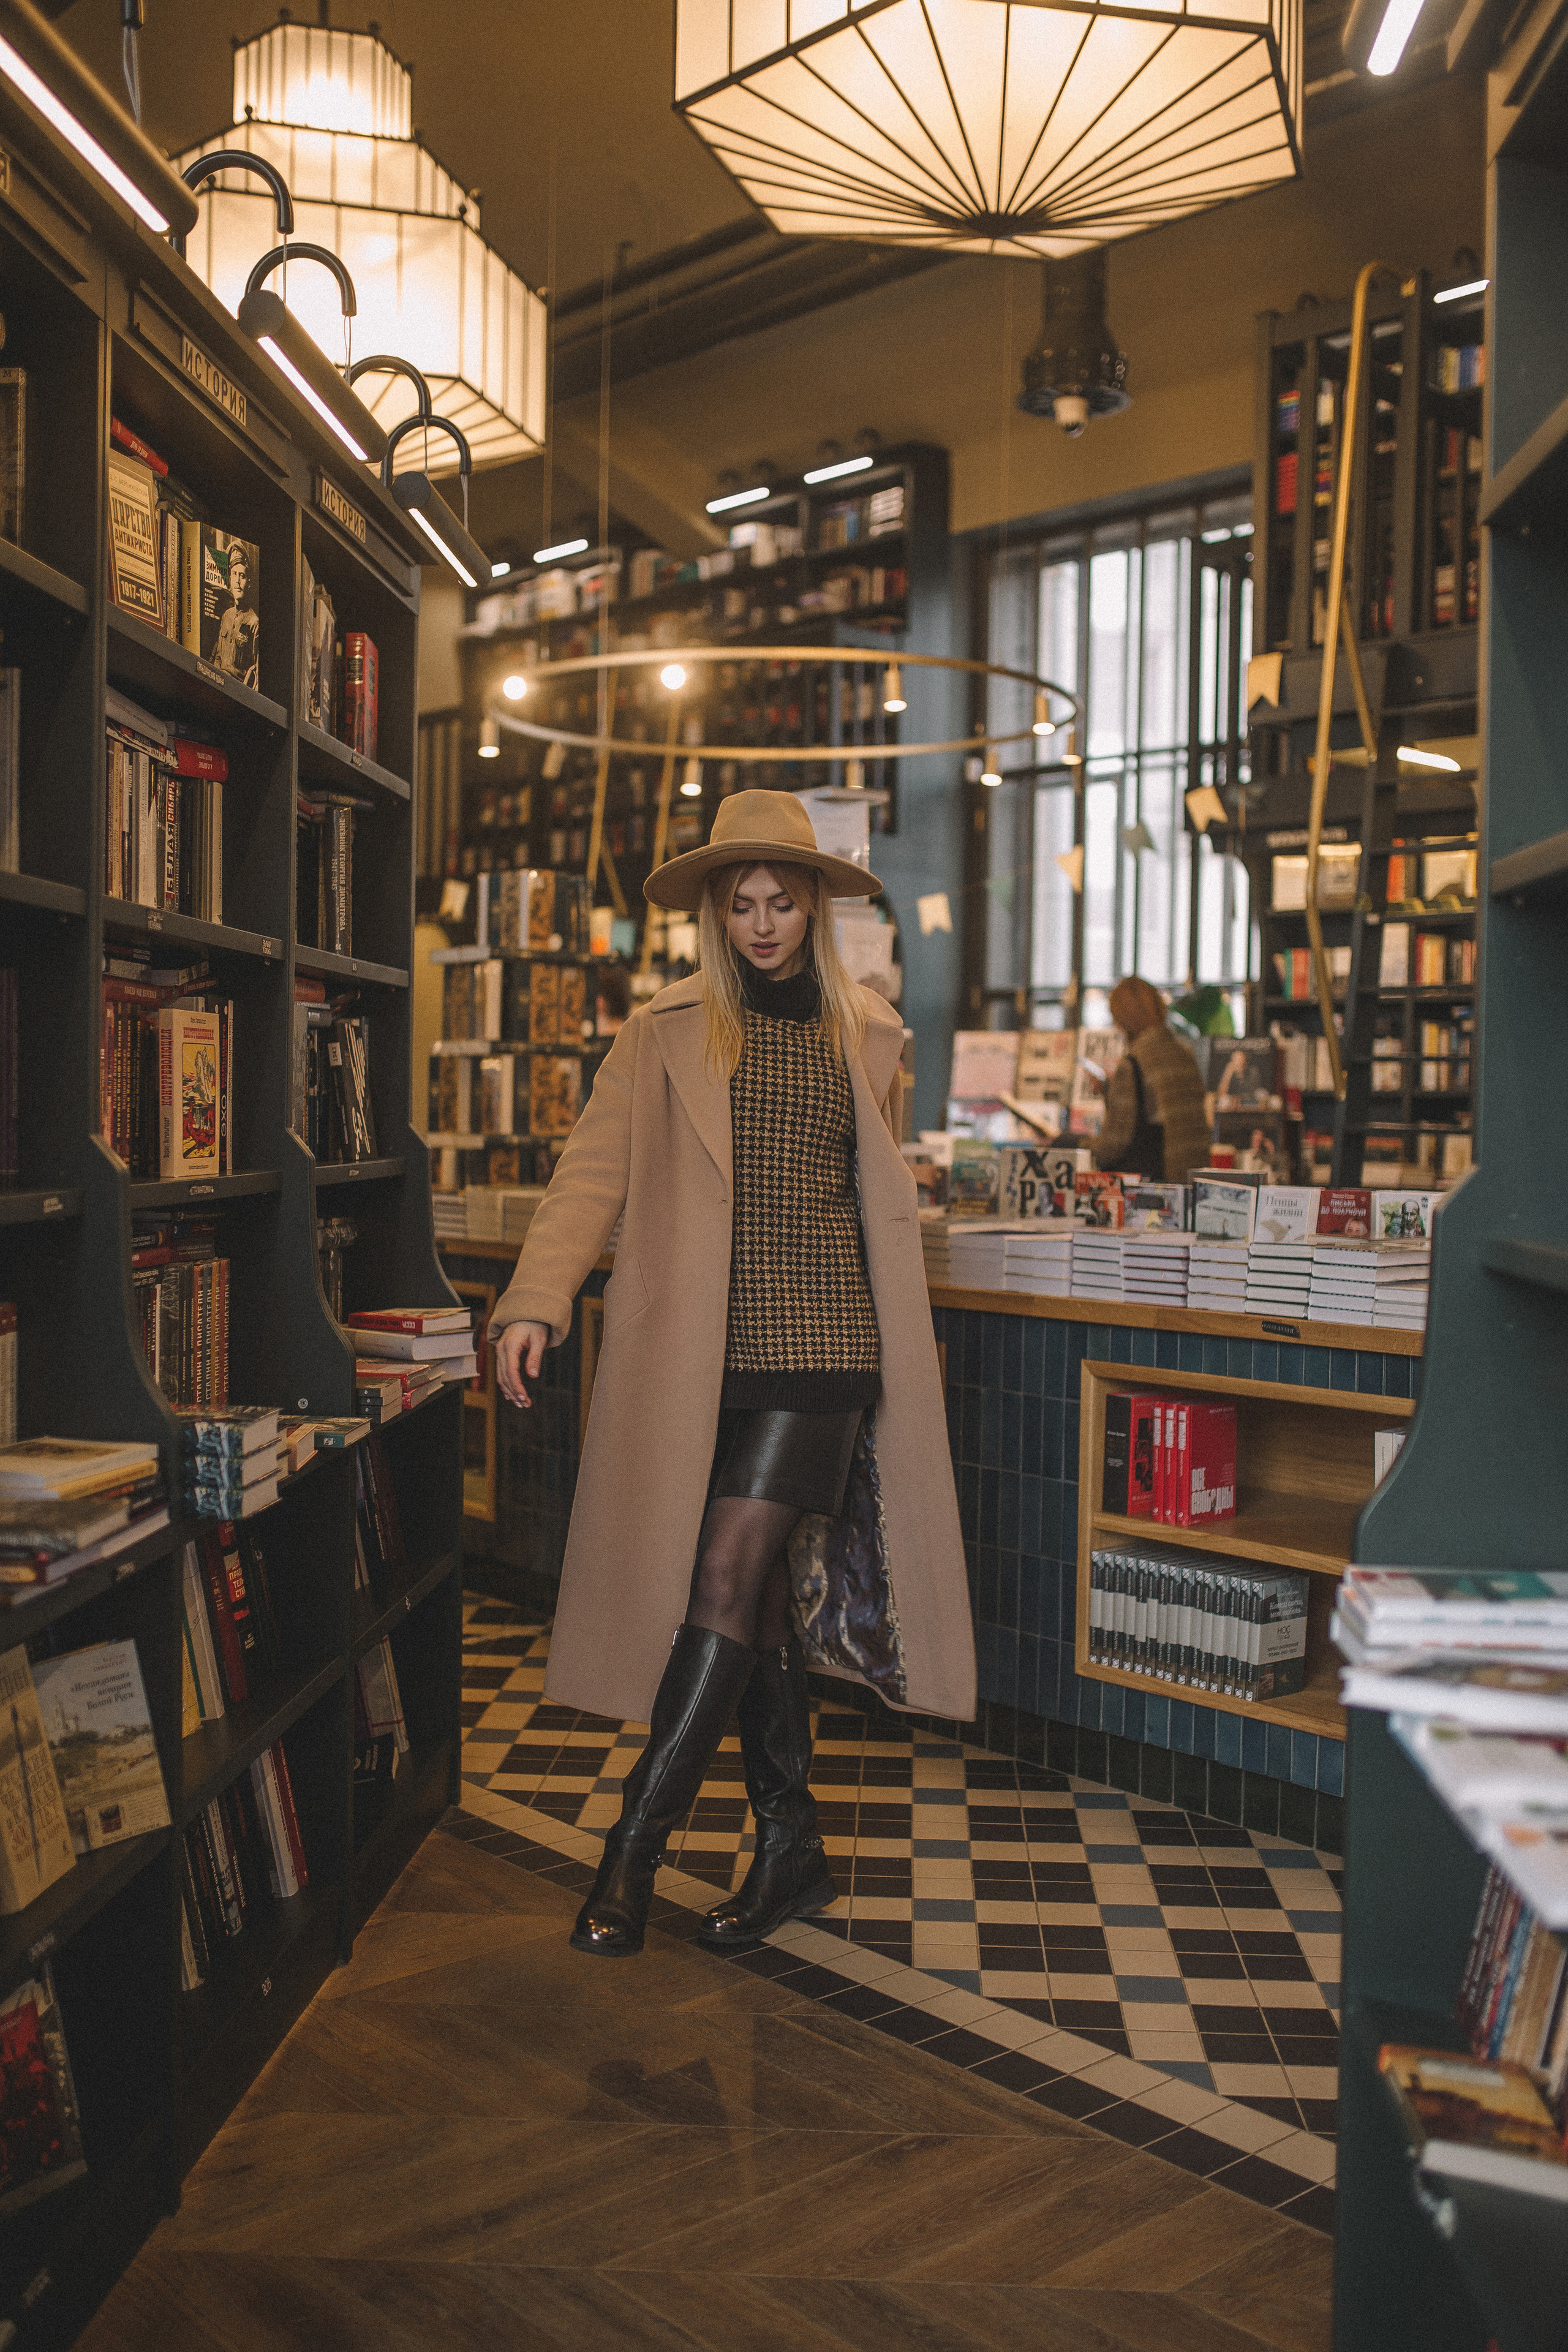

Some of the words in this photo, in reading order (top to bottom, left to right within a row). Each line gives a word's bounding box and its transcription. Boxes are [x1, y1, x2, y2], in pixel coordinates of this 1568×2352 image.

[185, 342, 245, 424] ИСТОРИЯ
[111, 496, 151, 541] ЦАРСТВО
[324, 482, 364, 541] ИСТОРИЯ
[115, 527, 153, 557] АНТИХРИСТА
[206, 561, 227, 575] ЗИМНЯЯ
[206, 571, 228, 586] ДОРОГА
[166, 823, 175, 892] БЕЛАЯ
[159, 1029, 172, 1106] КОНТРРЕВОЛЮЦИЯ
[86, 1696, 113, 1711] Белой
[113, 1691, 134, 1706] Руси
[97, 1681, 132, 1697] история
[214, 1819, 226, 1864] РОССИЙСКАЯ
